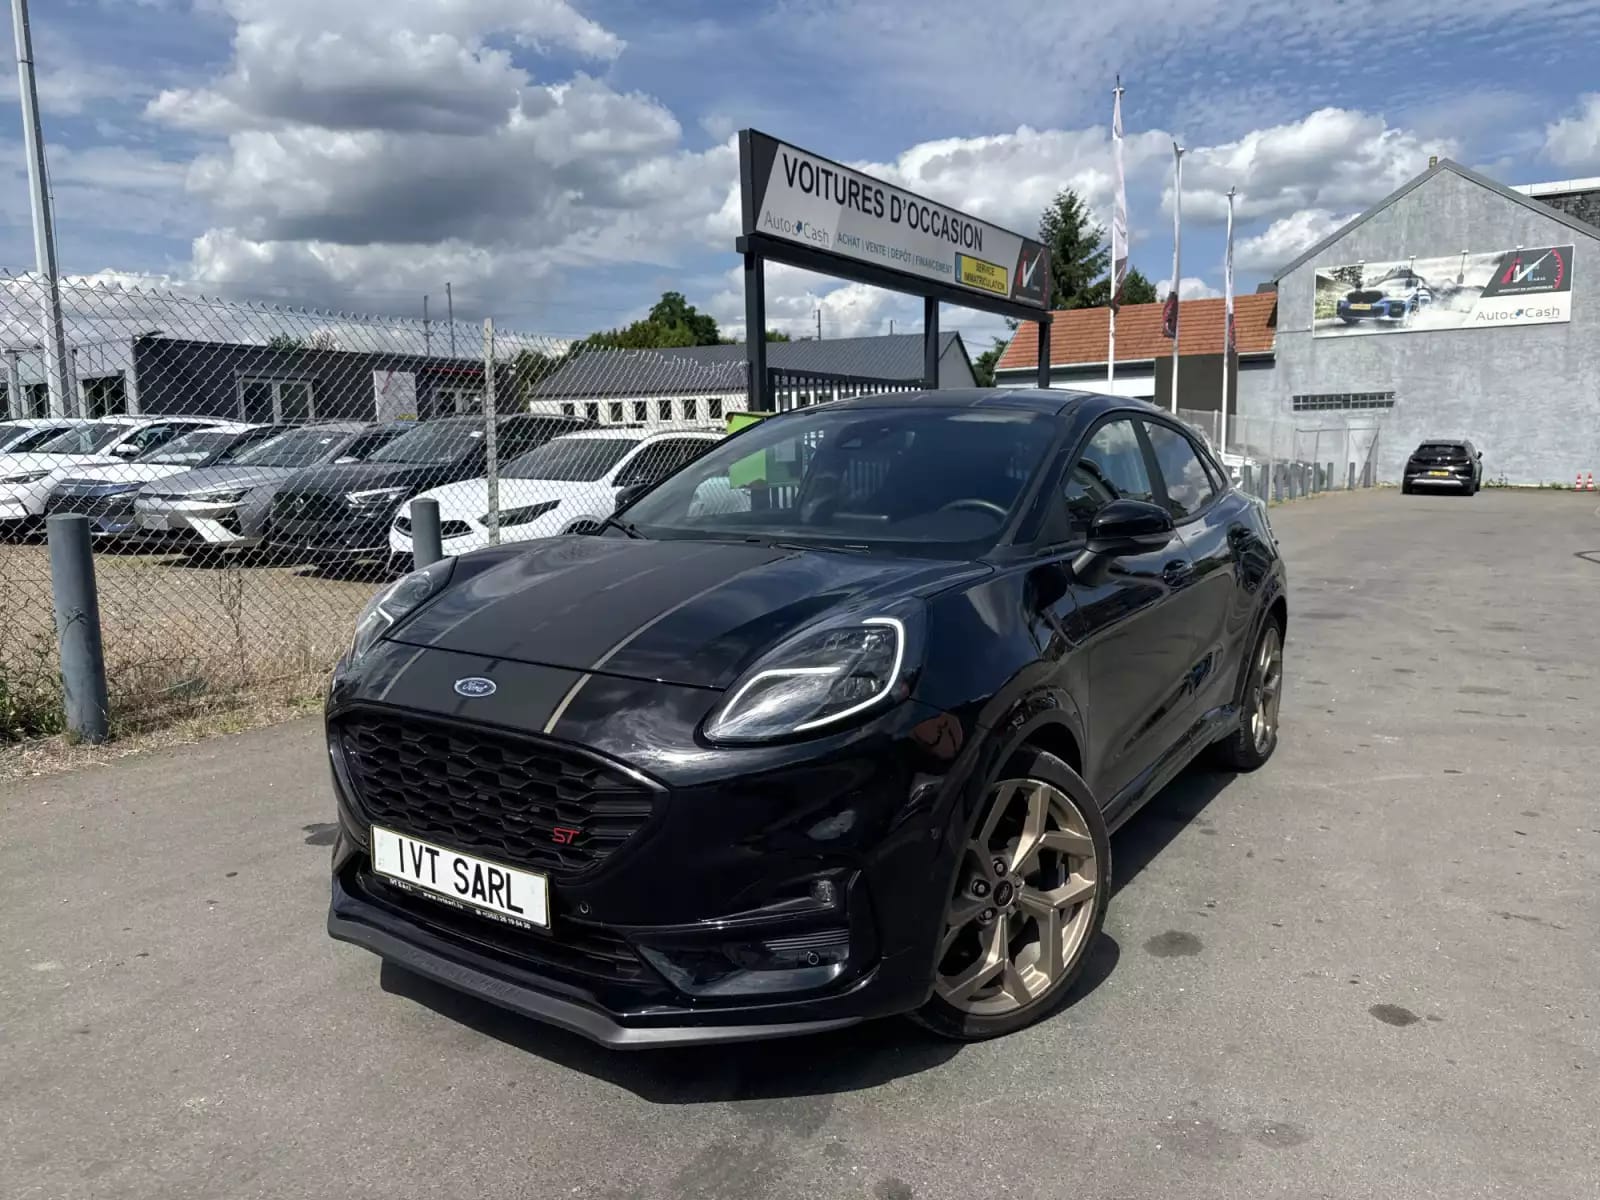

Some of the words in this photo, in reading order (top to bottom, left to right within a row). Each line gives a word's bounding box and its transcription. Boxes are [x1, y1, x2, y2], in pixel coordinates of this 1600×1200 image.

[783, 153, 884, 219] VOITURES
[890, 194, 983, 251] D'OCCASION
[837, 233, 861, 249] ACHAT
[865, 243, 886, 257] VENTE
[915, 255, 953, 274] FINANCEMENT
[963, 271, 1005, 290] IMMATRICULATION
[975, 262, 995, 277] SERVICE
[552, 827, 580, 845] ST
[398, 838, 440, 885] IVT
[453, 857, 524, 914] SARL
